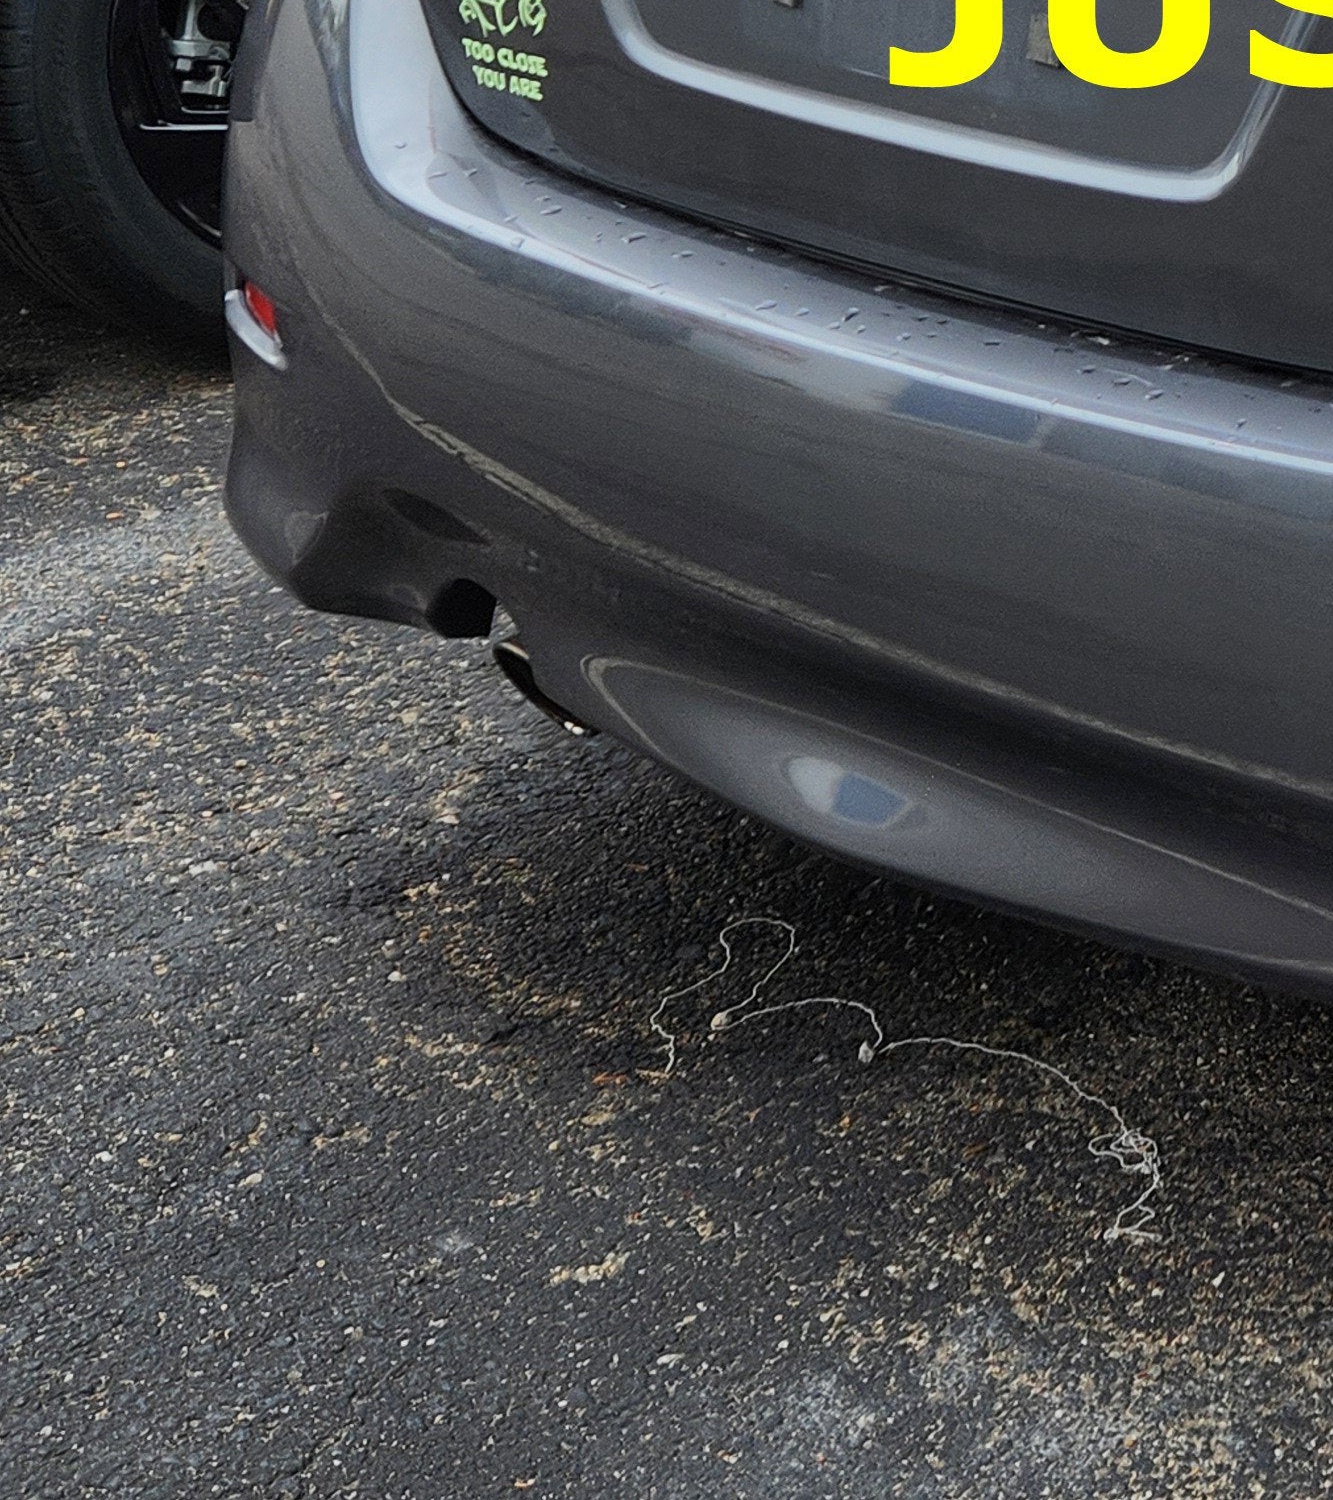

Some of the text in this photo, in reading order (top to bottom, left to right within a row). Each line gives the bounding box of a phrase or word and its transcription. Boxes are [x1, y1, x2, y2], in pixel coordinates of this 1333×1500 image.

[461, 37, 549, 78] TOO CLOSE
[472, 65, 544, 102] YOU ARE
